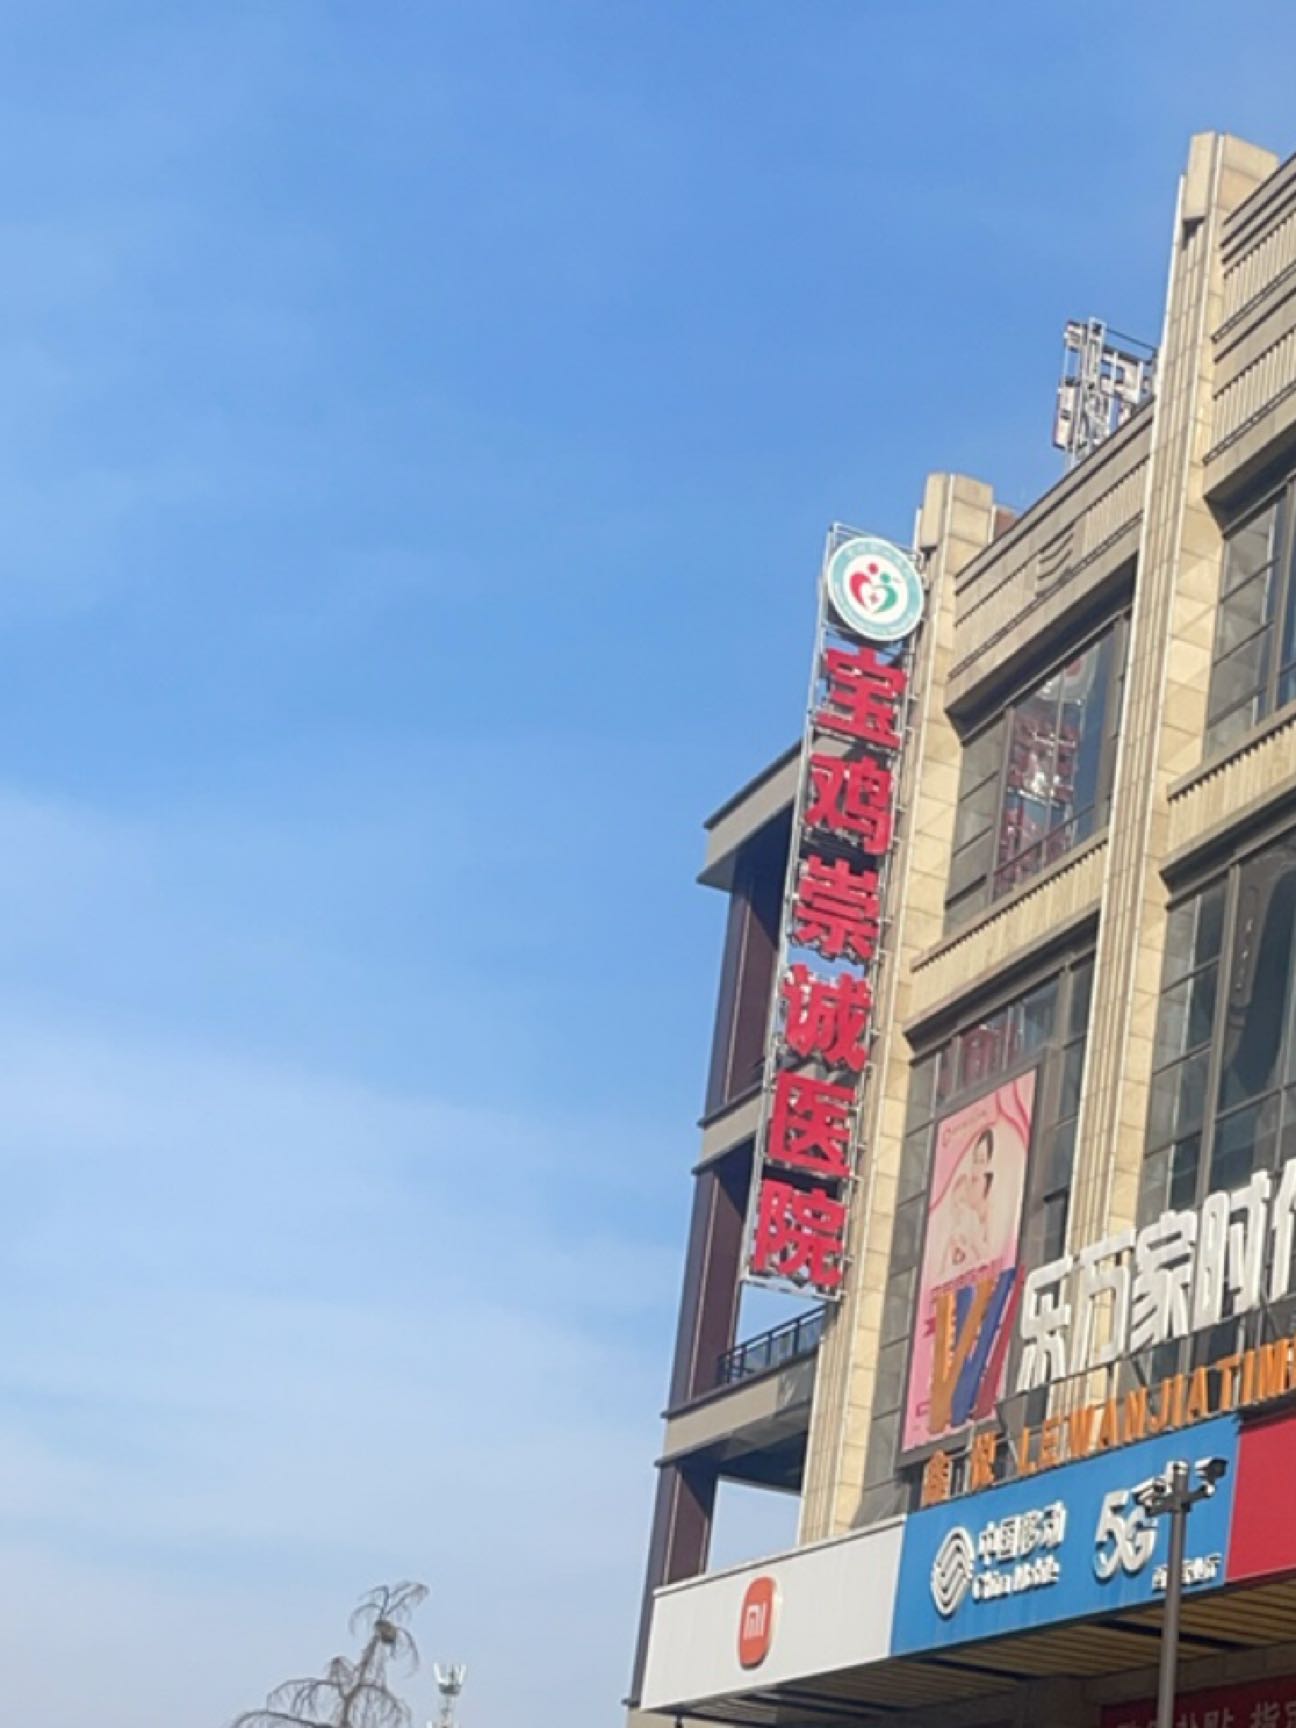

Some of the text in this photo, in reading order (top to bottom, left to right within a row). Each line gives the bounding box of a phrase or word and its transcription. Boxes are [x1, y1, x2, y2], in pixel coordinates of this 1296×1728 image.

[751, 646, 909, 1289] 宝鸡崇诚医院
[978, 1499, 1067, 1565] 中国移动
[1093, 1488, 1160, 1580] 5G
[972, 1554, 1061, 1600] China Mobile
